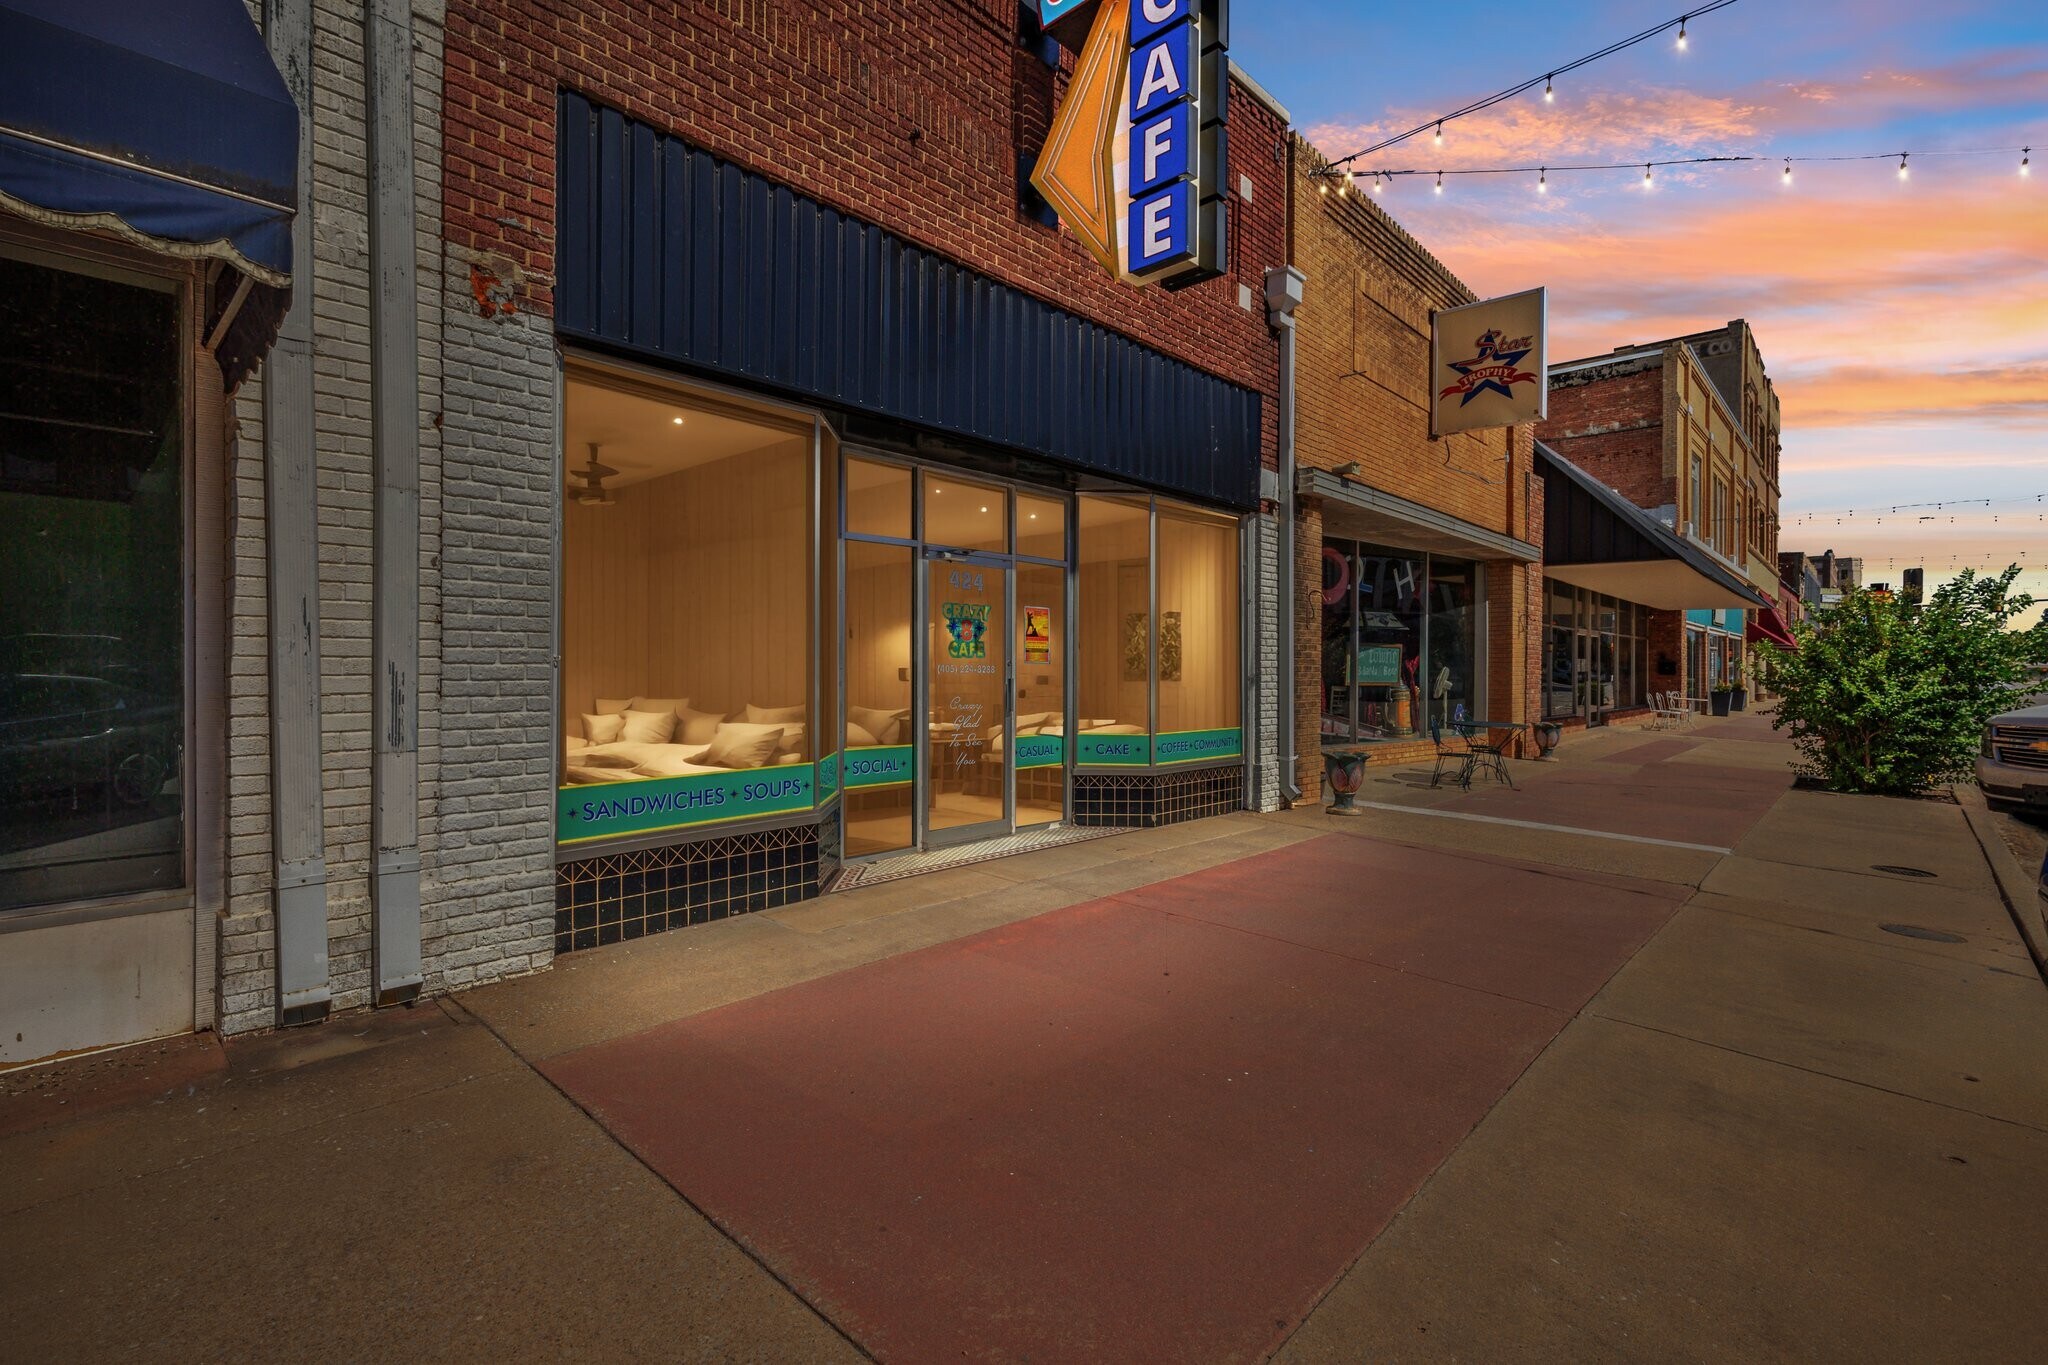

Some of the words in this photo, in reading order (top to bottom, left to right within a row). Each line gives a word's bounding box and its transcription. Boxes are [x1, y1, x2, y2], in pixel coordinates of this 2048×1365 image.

[1458, 330, 1534, 367] Star
[1462, 367, 1514, 385] TROPHY
[950, 570, 984, 592] 424
[942, 602, 991, 622] CRAZY
[961, 620, 973, 642] 8
[948, 641, 986, 658] CAFE
[949, 696, 983, 716] Crazy
[953, 715, 982, 731] Glad
[949, 733, 963, 747] To
[965, 733, 983, 747] See
[1095, 743, 1130, 755] CAKE
[1161, 740, 1189, 754] COFFEE
[1019, 744, 1055, 758] CASUAL
[852, 758, 899, 776] SOCIAL
[955, 752, 976, 771] You
[582, 787, 726, 822] SANDWICHES
[743, 778, 802, 801] SOUPS
